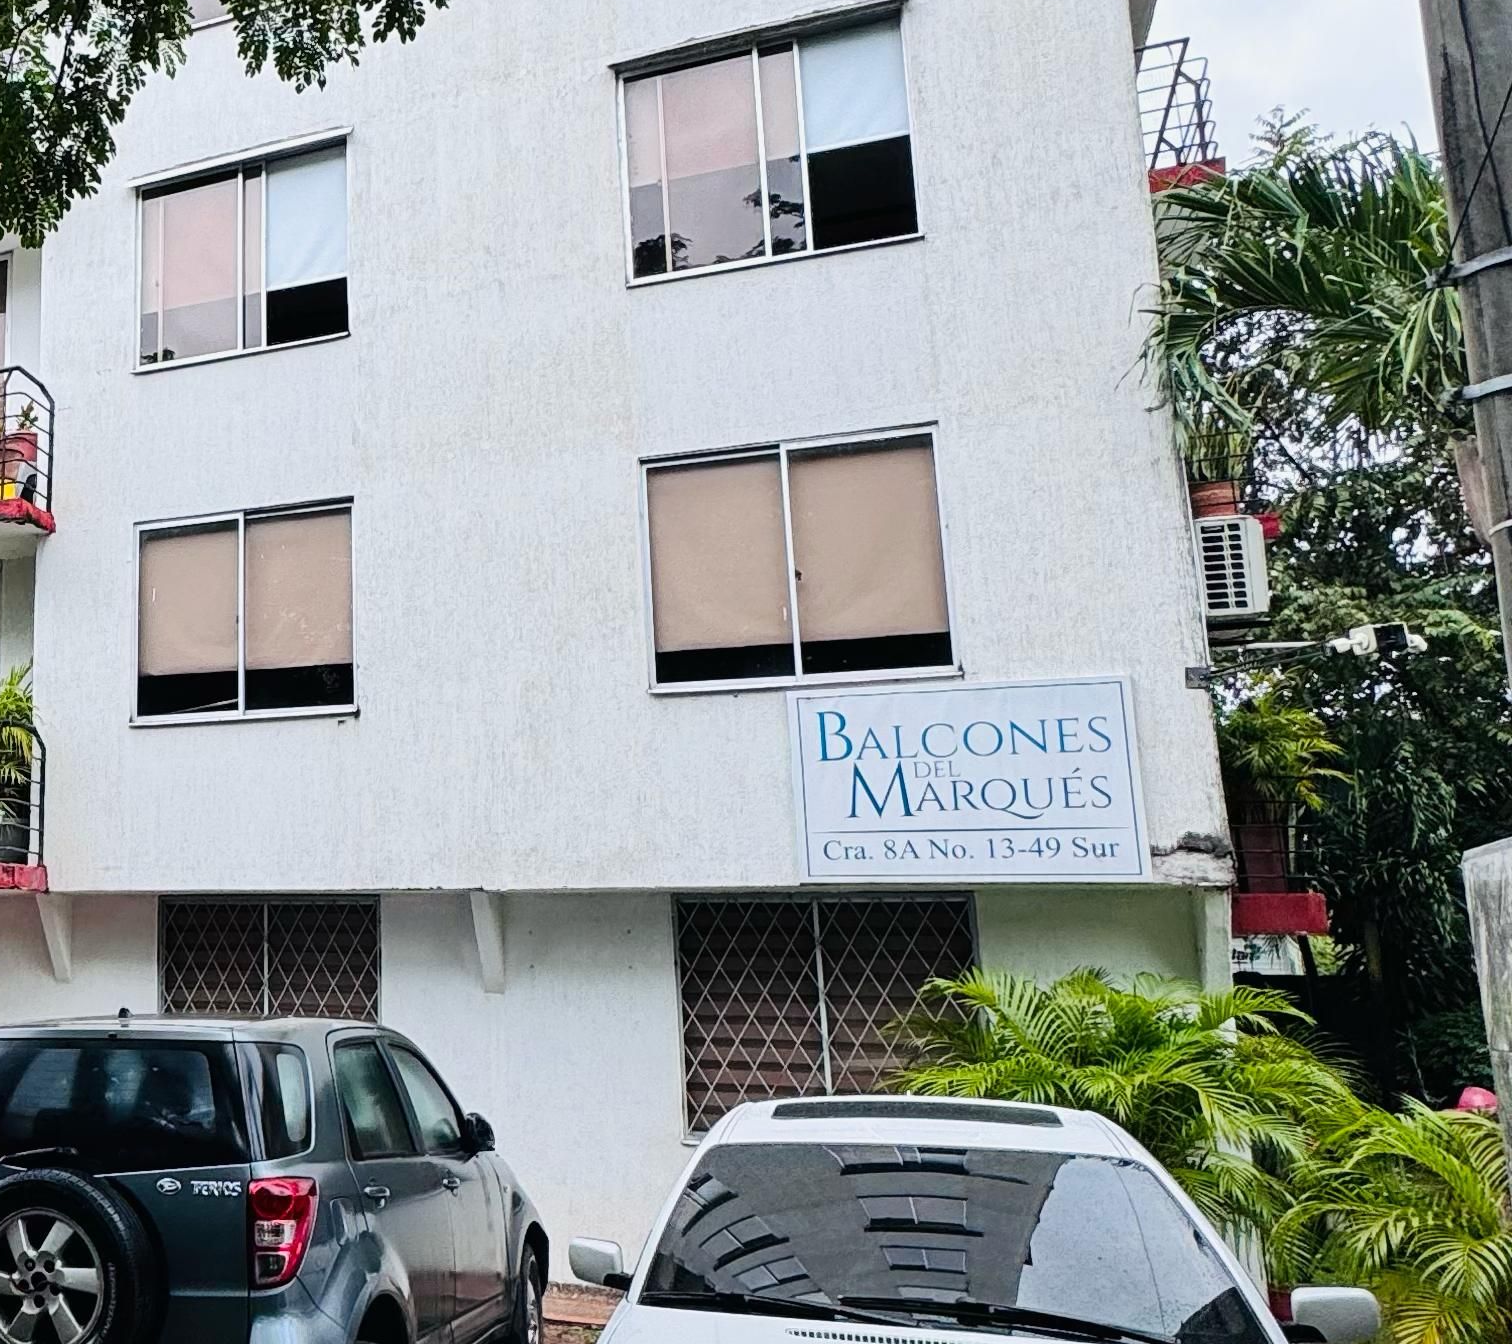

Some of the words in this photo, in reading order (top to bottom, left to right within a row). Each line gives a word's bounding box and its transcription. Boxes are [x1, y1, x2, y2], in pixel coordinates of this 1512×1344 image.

[816, 710, 1112, 762] BALCONES
[913, 760, 961, 779] DEL
[847, 760, 1113, 820] MARQUÉS
[823, 839, 874, 861] Cra.
[883, 838, 920, 860] 8A
[928, 838, 974, 860] No.
[987, 836, 1061, 859] 13-49
[1072, 836, 1120, 858] Sur
